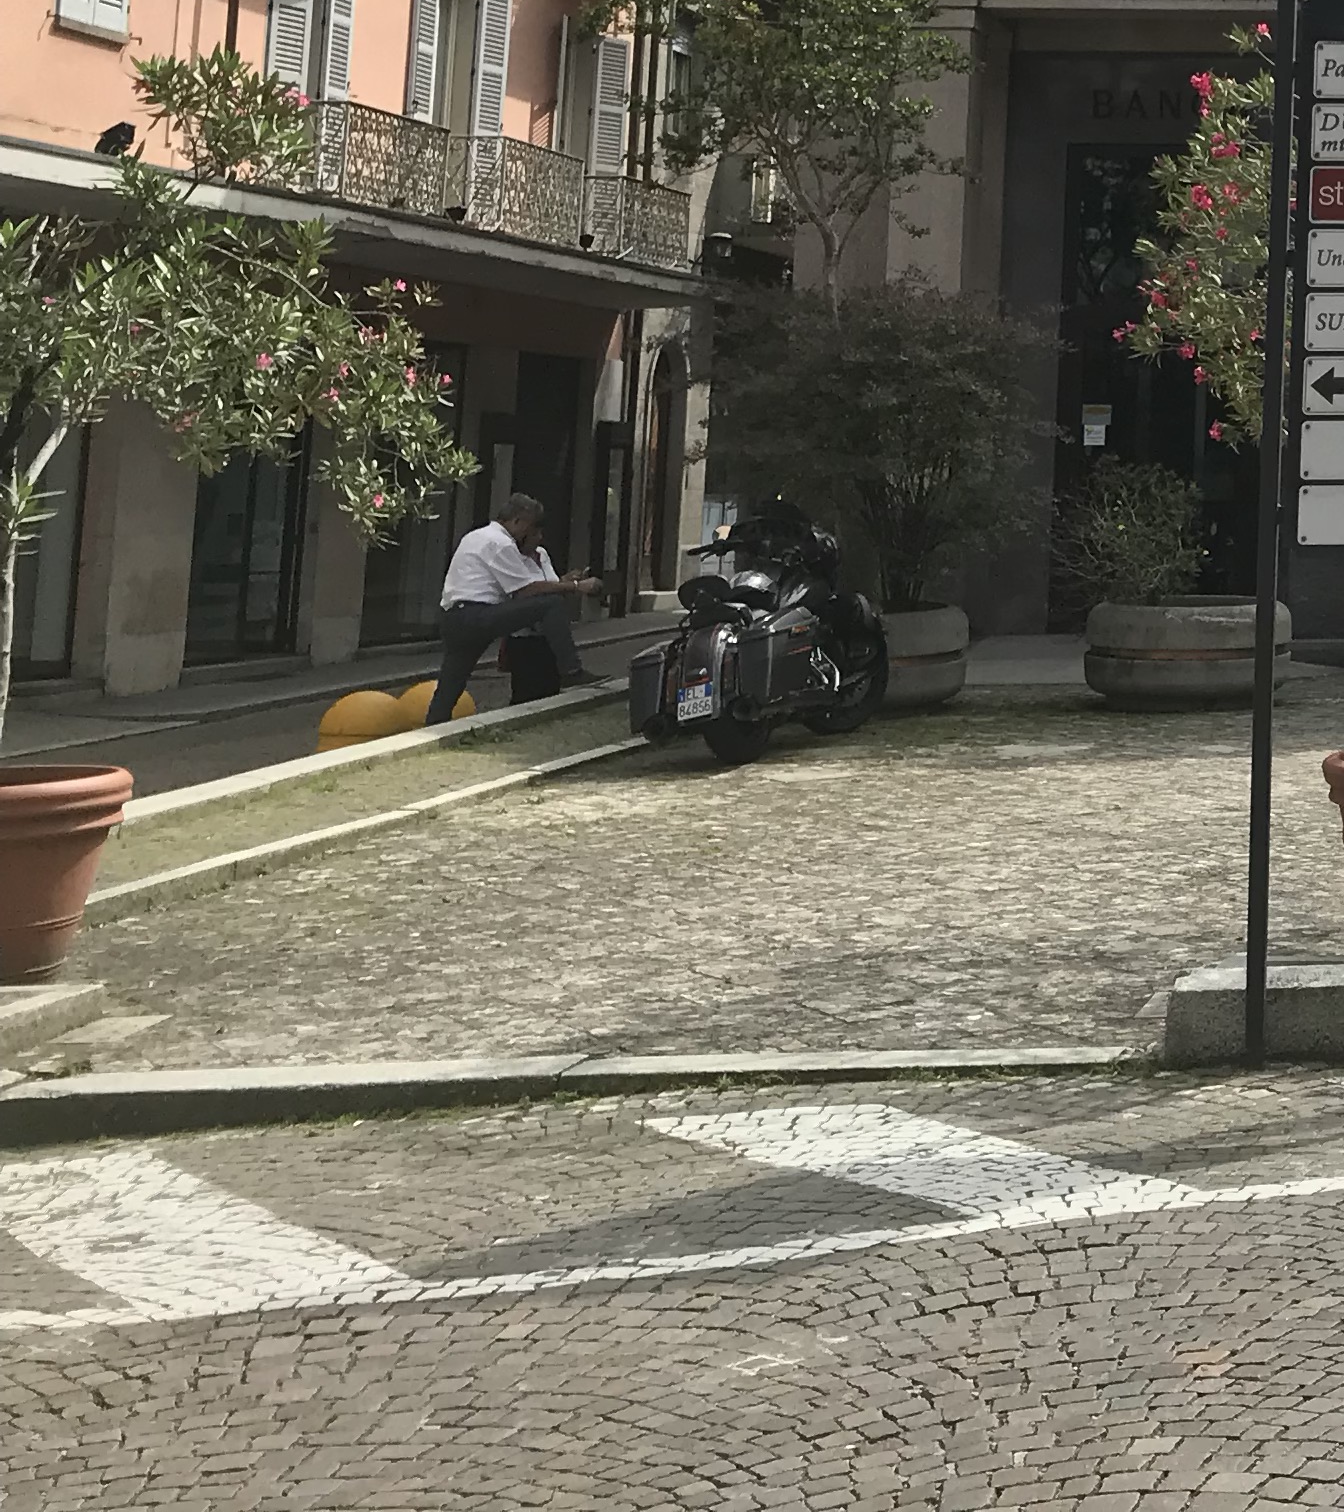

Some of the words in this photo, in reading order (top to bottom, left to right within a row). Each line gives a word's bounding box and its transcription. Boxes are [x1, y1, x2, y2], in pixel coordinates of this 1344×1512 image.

[1092, 89, 1200, 119] BAN
[686, 687, 699, 700] EL
[679, 699, 711, 717] 84856
